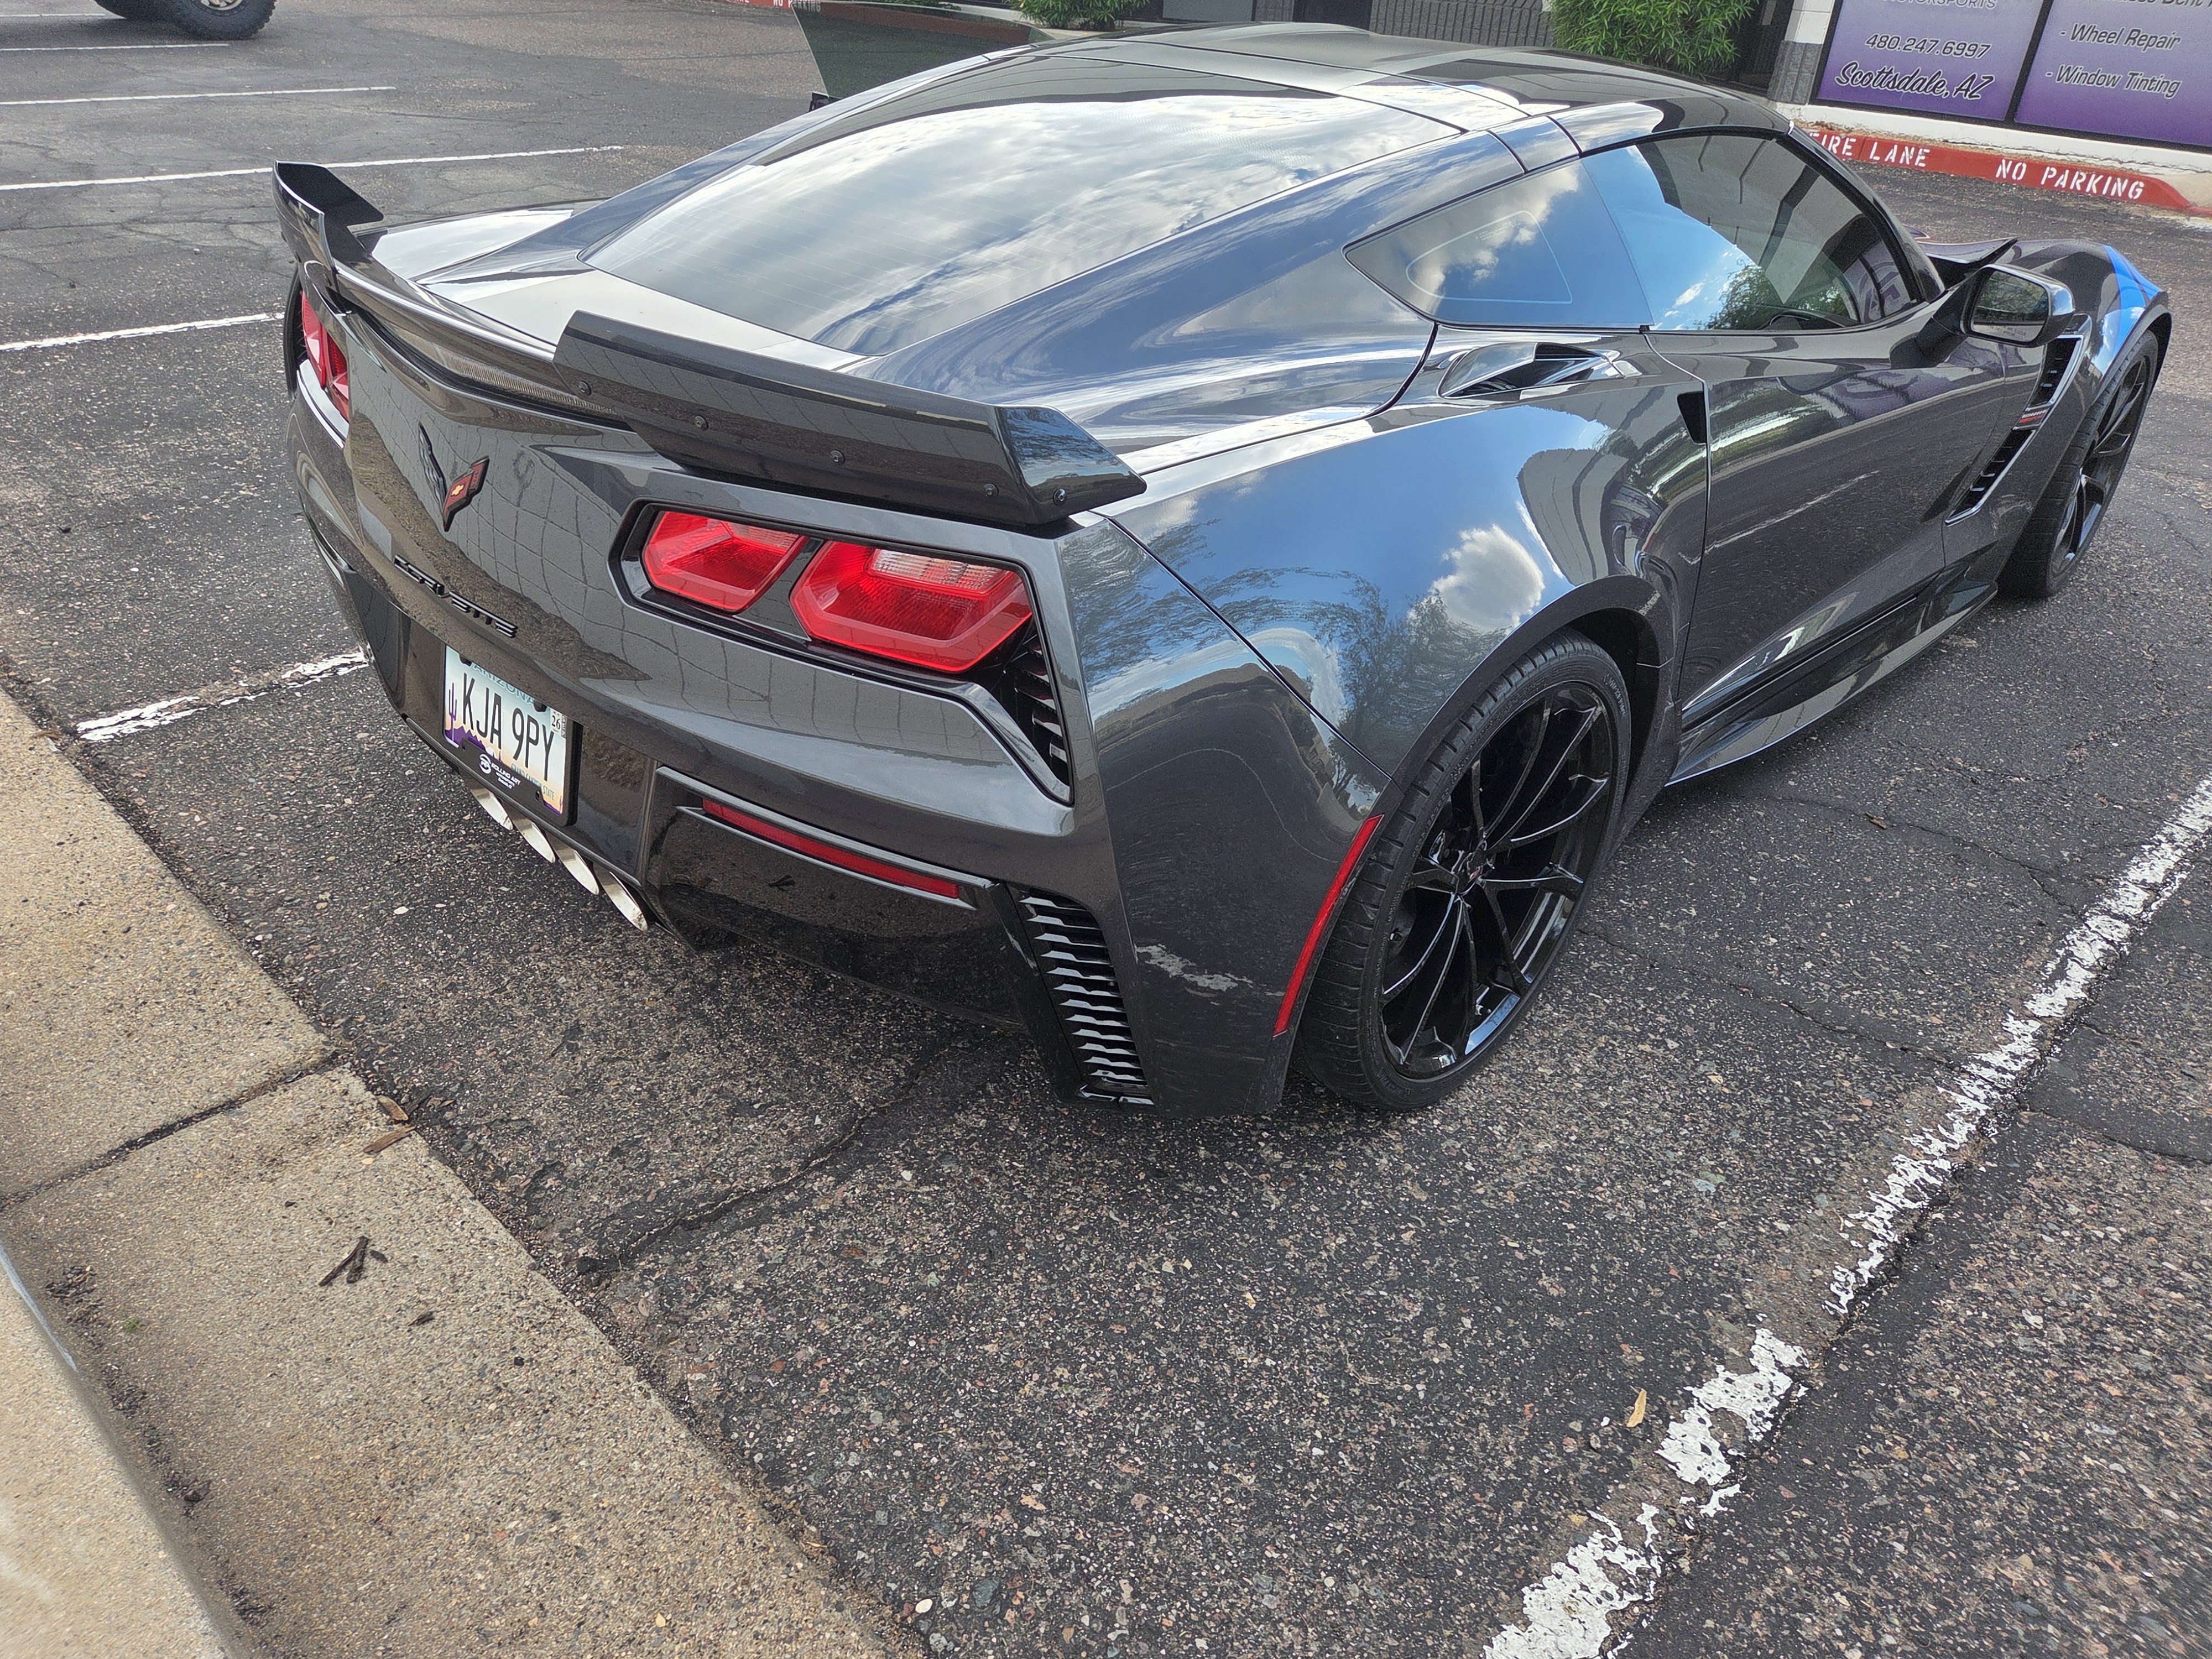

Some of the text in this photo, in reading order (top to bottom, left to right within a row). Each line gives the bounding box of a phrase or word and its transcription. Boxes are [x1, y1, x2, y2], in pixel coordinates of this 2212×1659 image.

[1865, 33, 1991, 59] 480.247.6997
[2069, 23, 2181, 52] Wheel Repair
[1835, 61, 1995, 100] Scottsdale, AZ
[2056, 65, 2182, 98] Window Tinting
[1869, 141, 1931, 167] LANE
[1995, 158, 2145, 200] NO PARKING
[463, 672, 555, 782] KJA 9PY
[551, 714, 561, 730] 26
